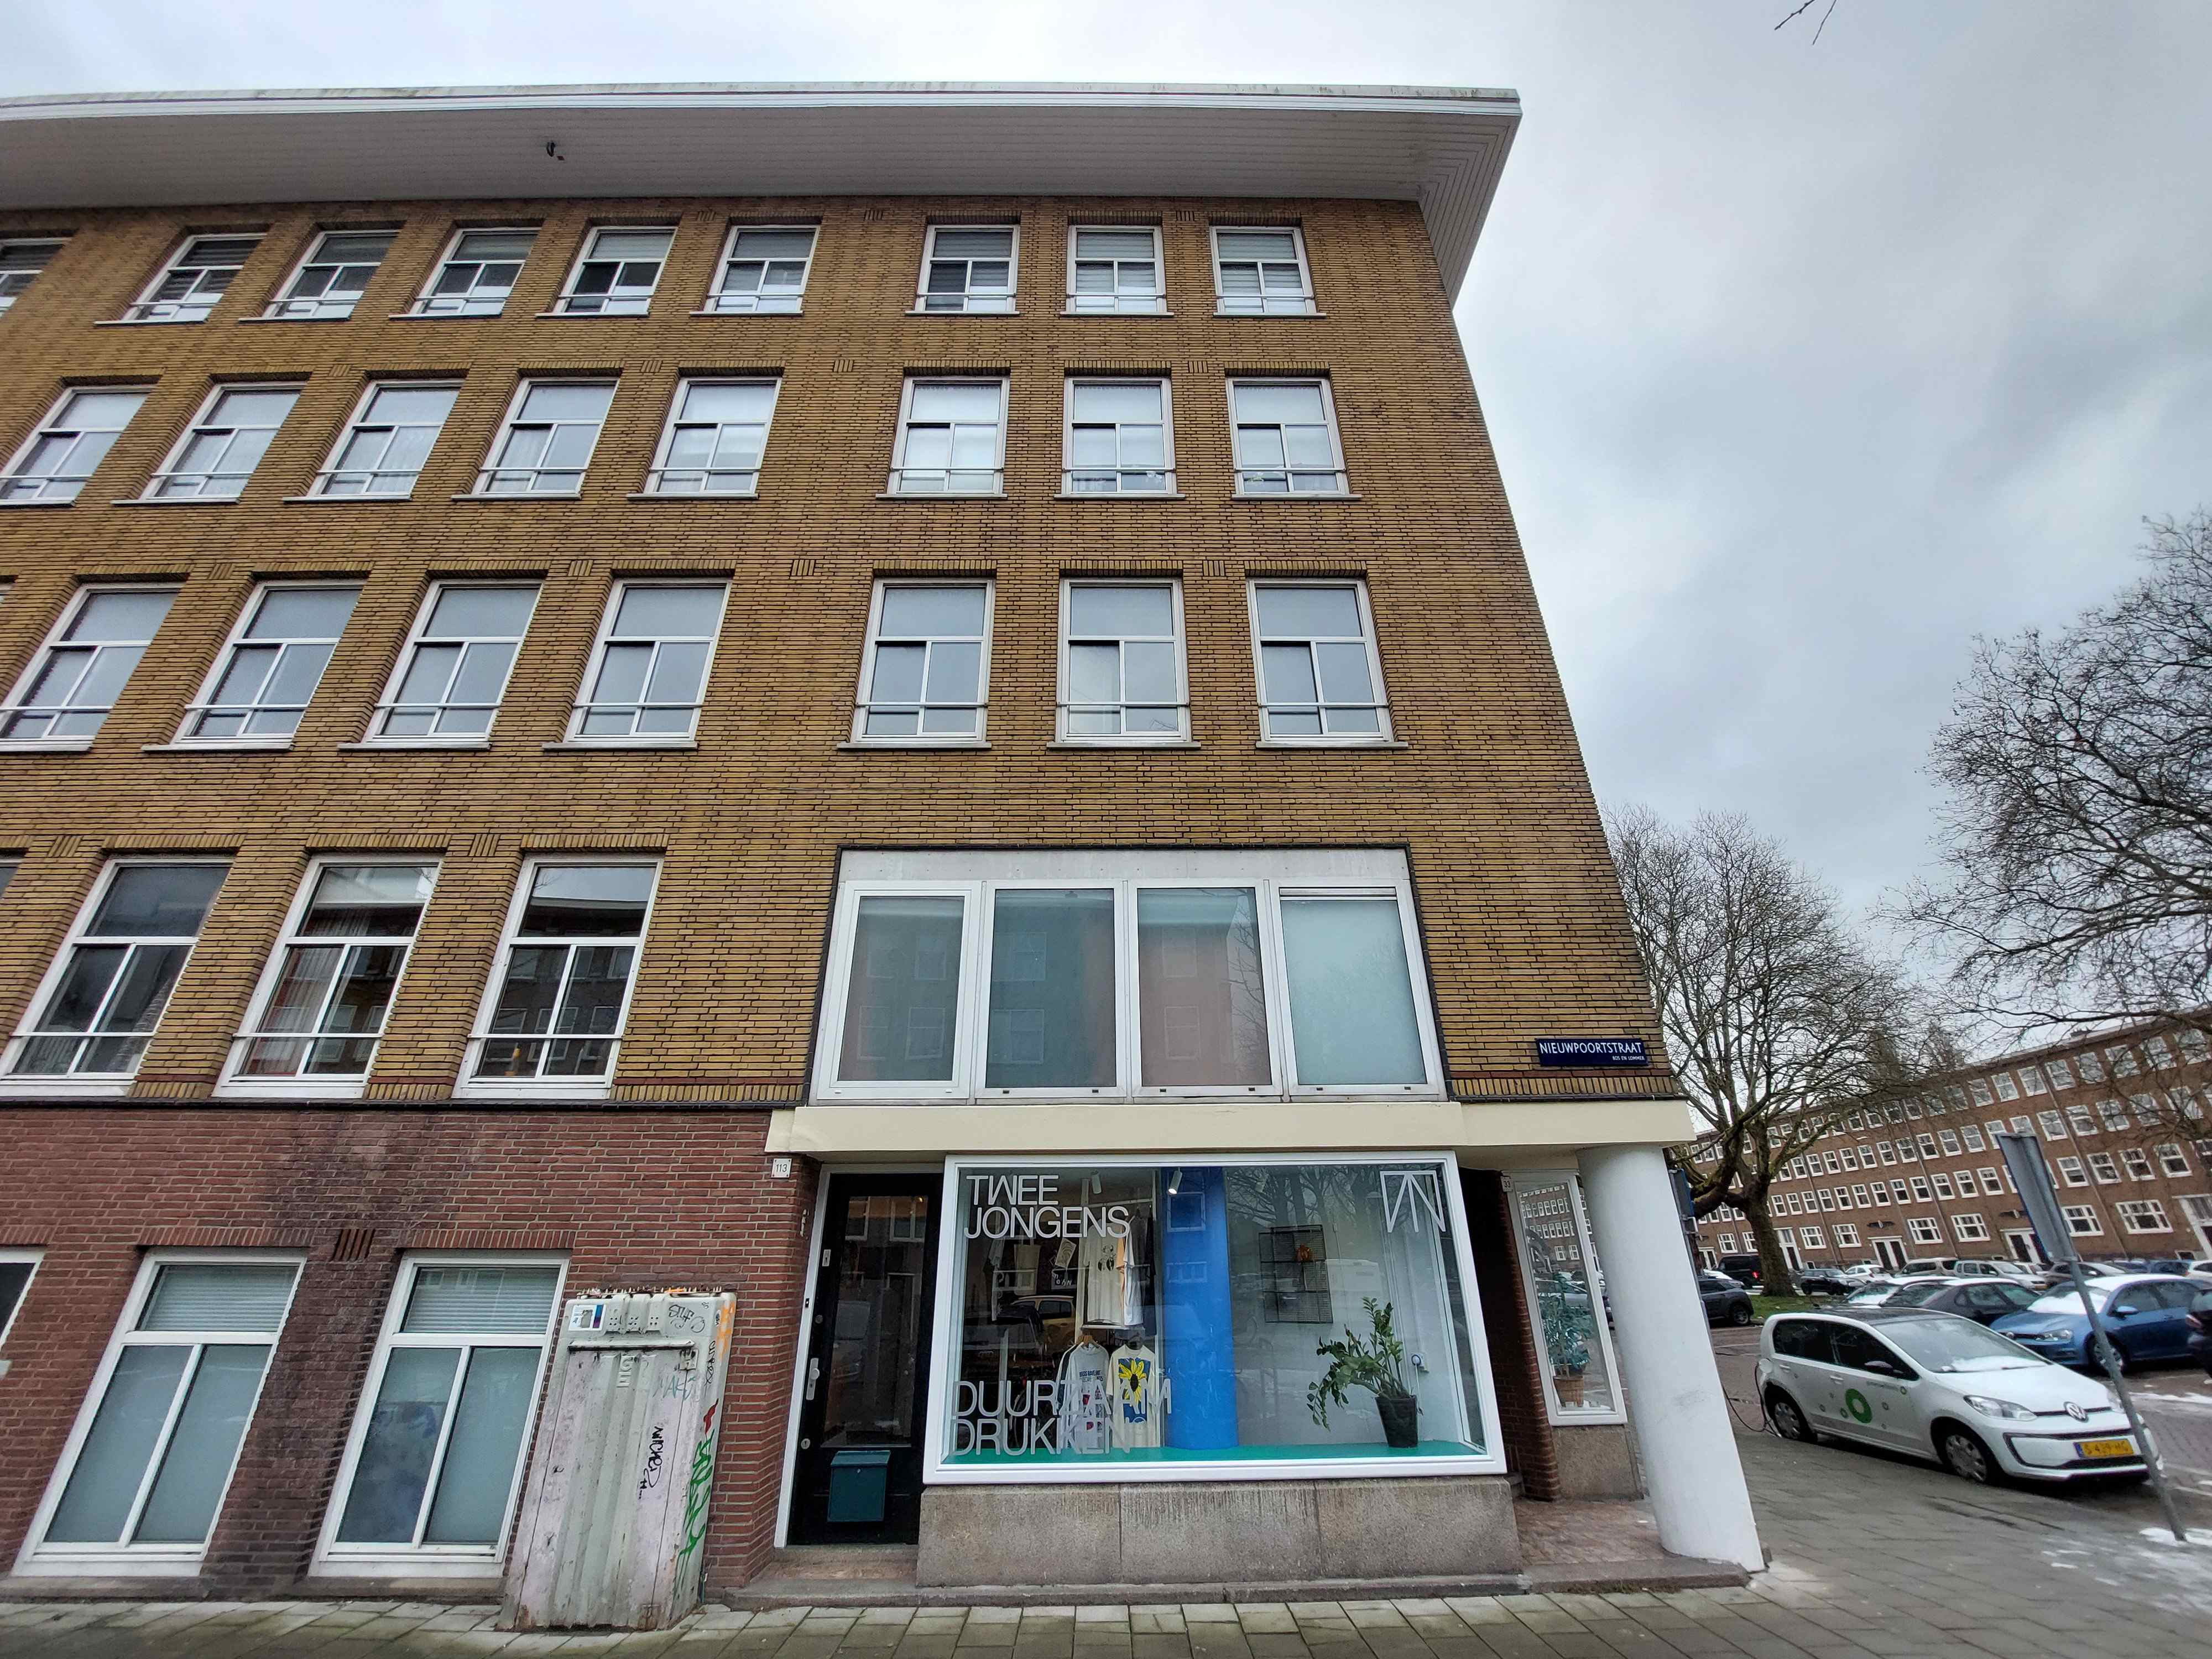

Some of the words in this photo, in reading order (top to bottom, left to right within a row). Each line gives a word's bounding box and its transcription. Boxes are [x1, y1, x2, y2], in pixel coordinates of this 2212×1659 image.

[1539, 1042, 1641, 1053] NIEUWPOORTSTRAAT
[776, 1164, 787, 1173] 113
[966, 1175, 1059, 1206] TWEE
[964, 1206, 1131, 1239] JONGENS
[954, 1417, 1130, 1456] DRUKKEN
